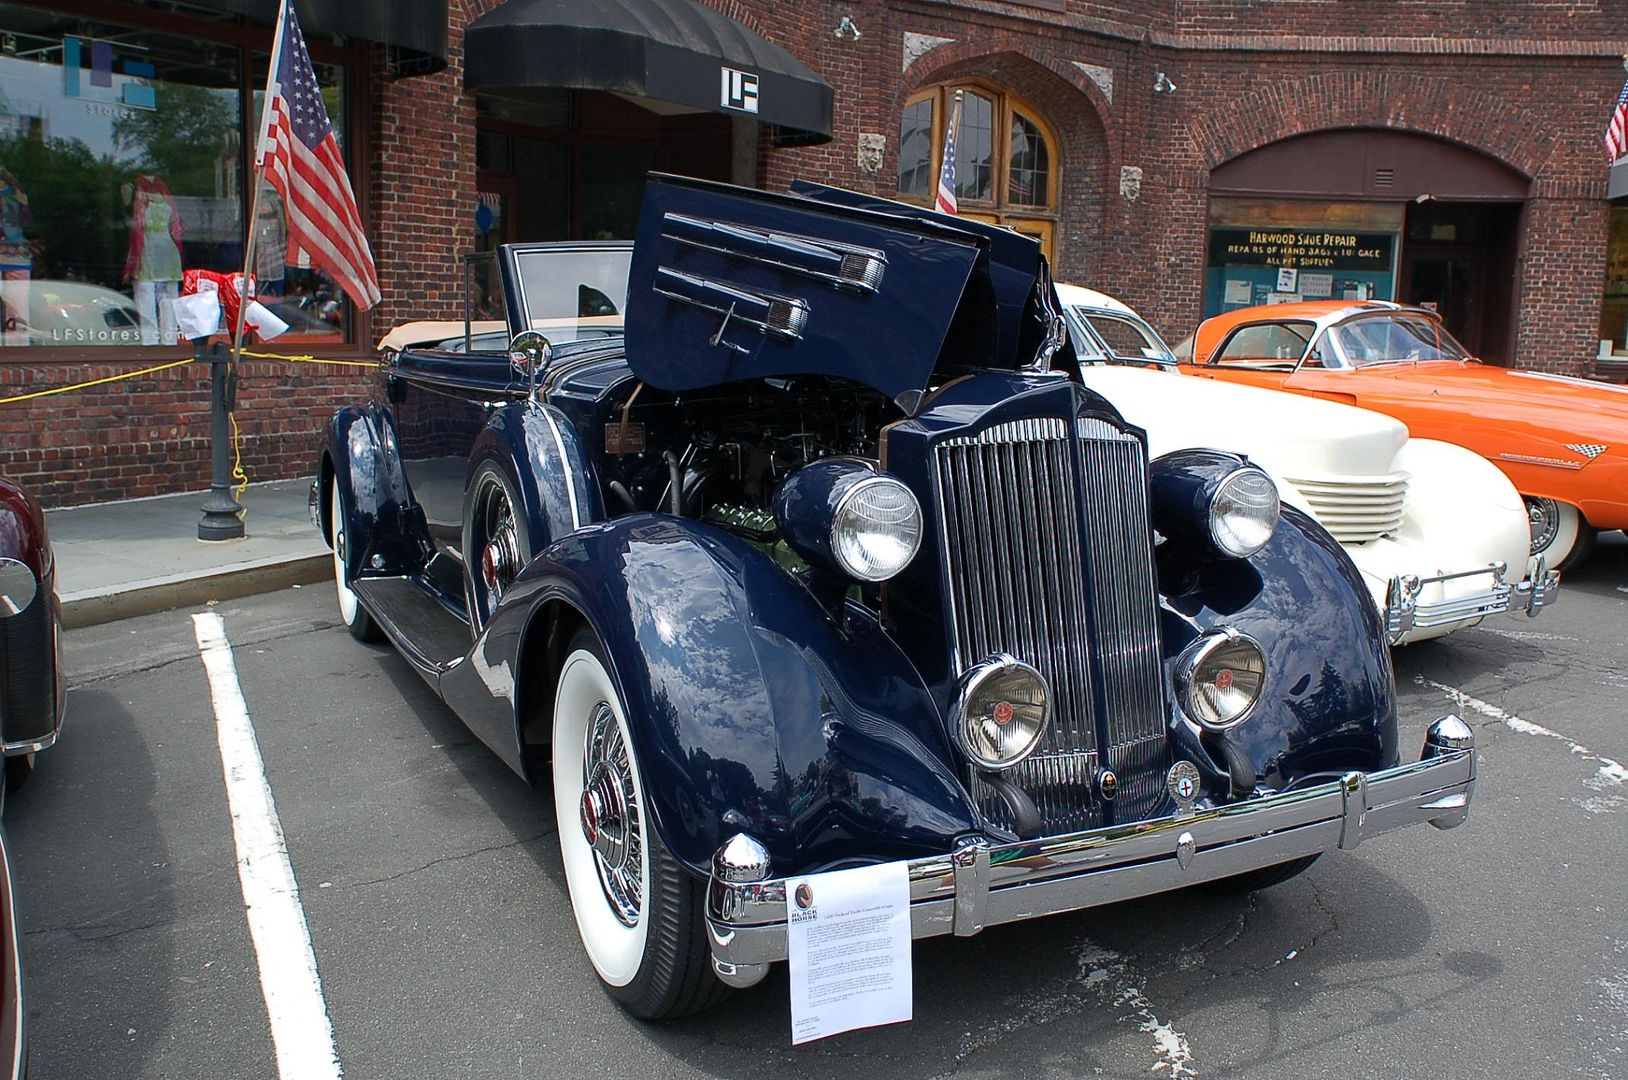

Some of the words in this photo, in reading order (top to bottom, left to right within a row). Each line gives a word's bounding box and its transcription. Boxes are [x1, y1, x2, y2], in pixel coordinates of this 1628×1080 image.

[86, 103, 137, 119] Stores
[1249, 232, 1295, 245] HARWOOD
[1323, 233, 1357, 247] REPAIR
[1228, 245, 1263, 254] REPARS
[1266, 246, 1278, 254] OF
[1266, 257, 1280, 265] ALL
[53, 328, 186, 341] LFStorescom
[791, 909, 818, 918] BLACK
[791, 914, 818, 923] HORSE
